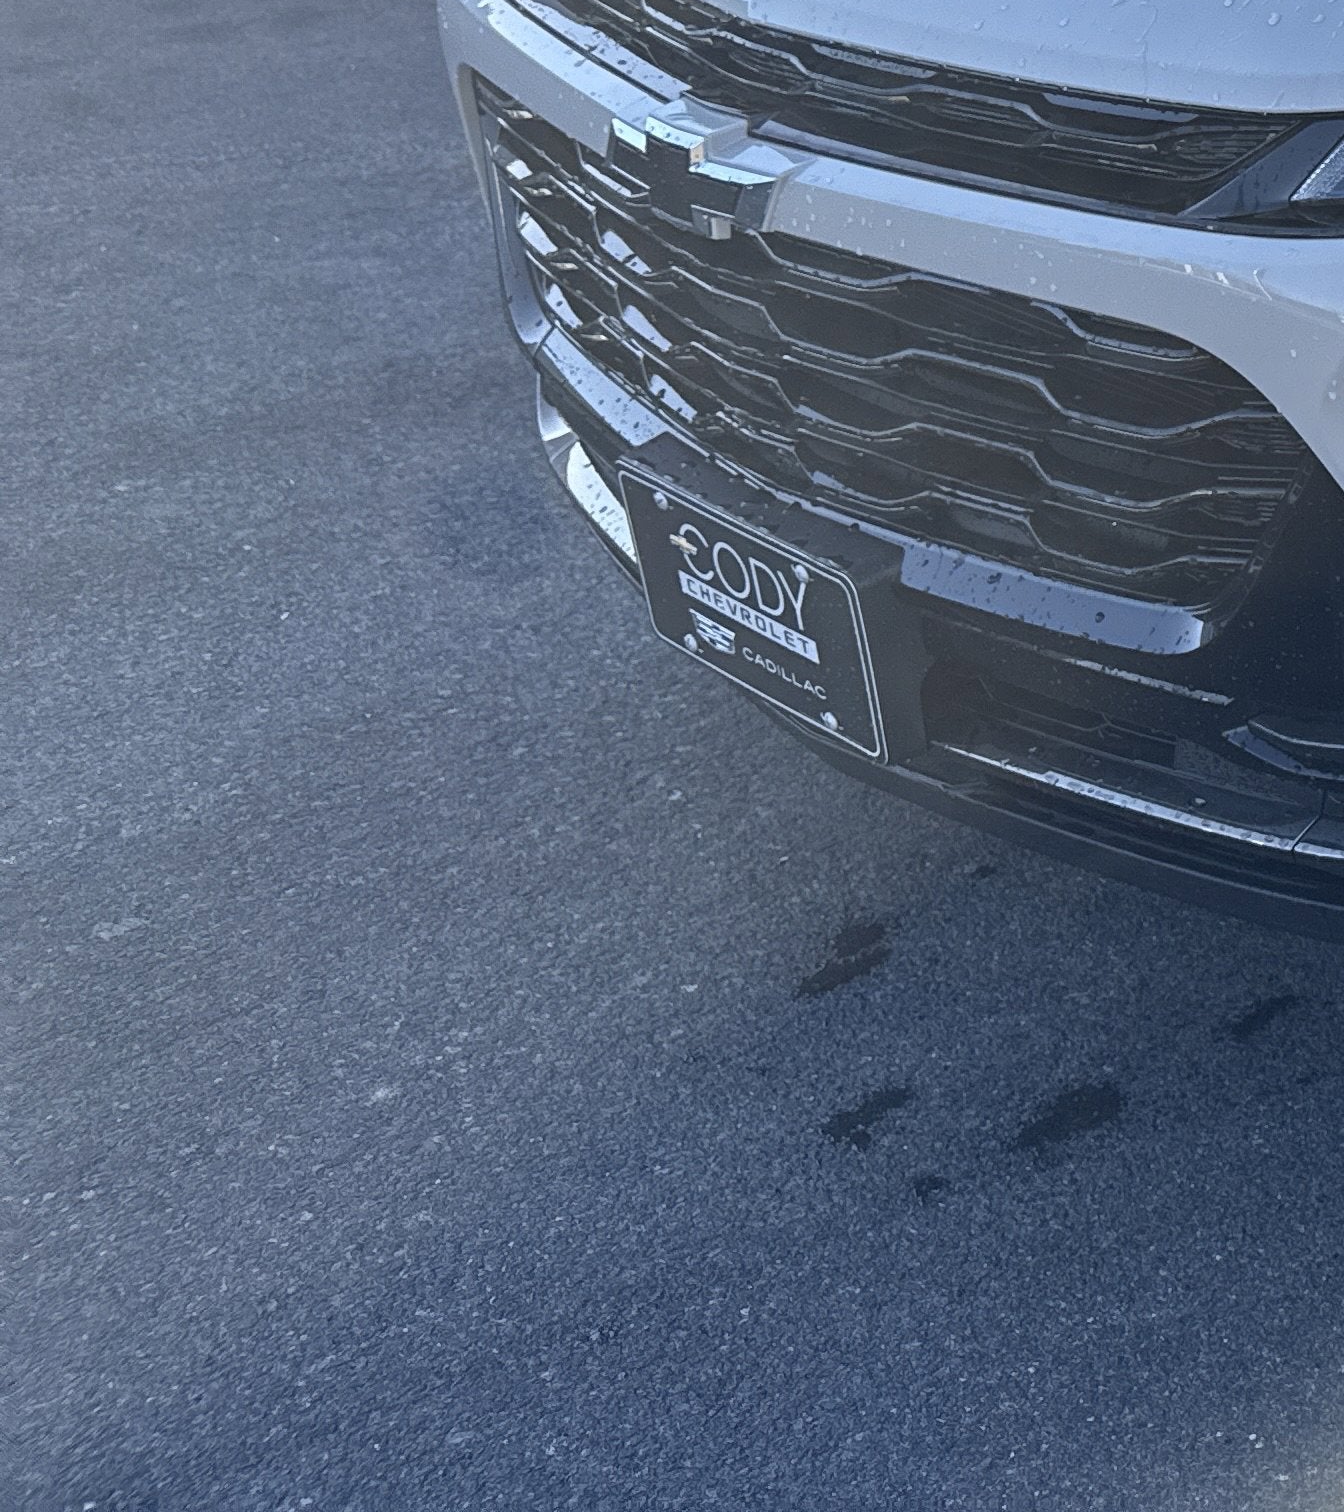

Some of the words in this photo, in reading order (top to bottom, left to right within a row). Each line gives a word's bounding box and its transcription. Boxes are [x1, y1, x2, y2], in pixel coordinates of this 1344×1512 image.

[679, 523, 808, 631] CODY
[686, 578, 811, 655] CHEVROLET
[742, 647, 828, 700] CADILLAC
